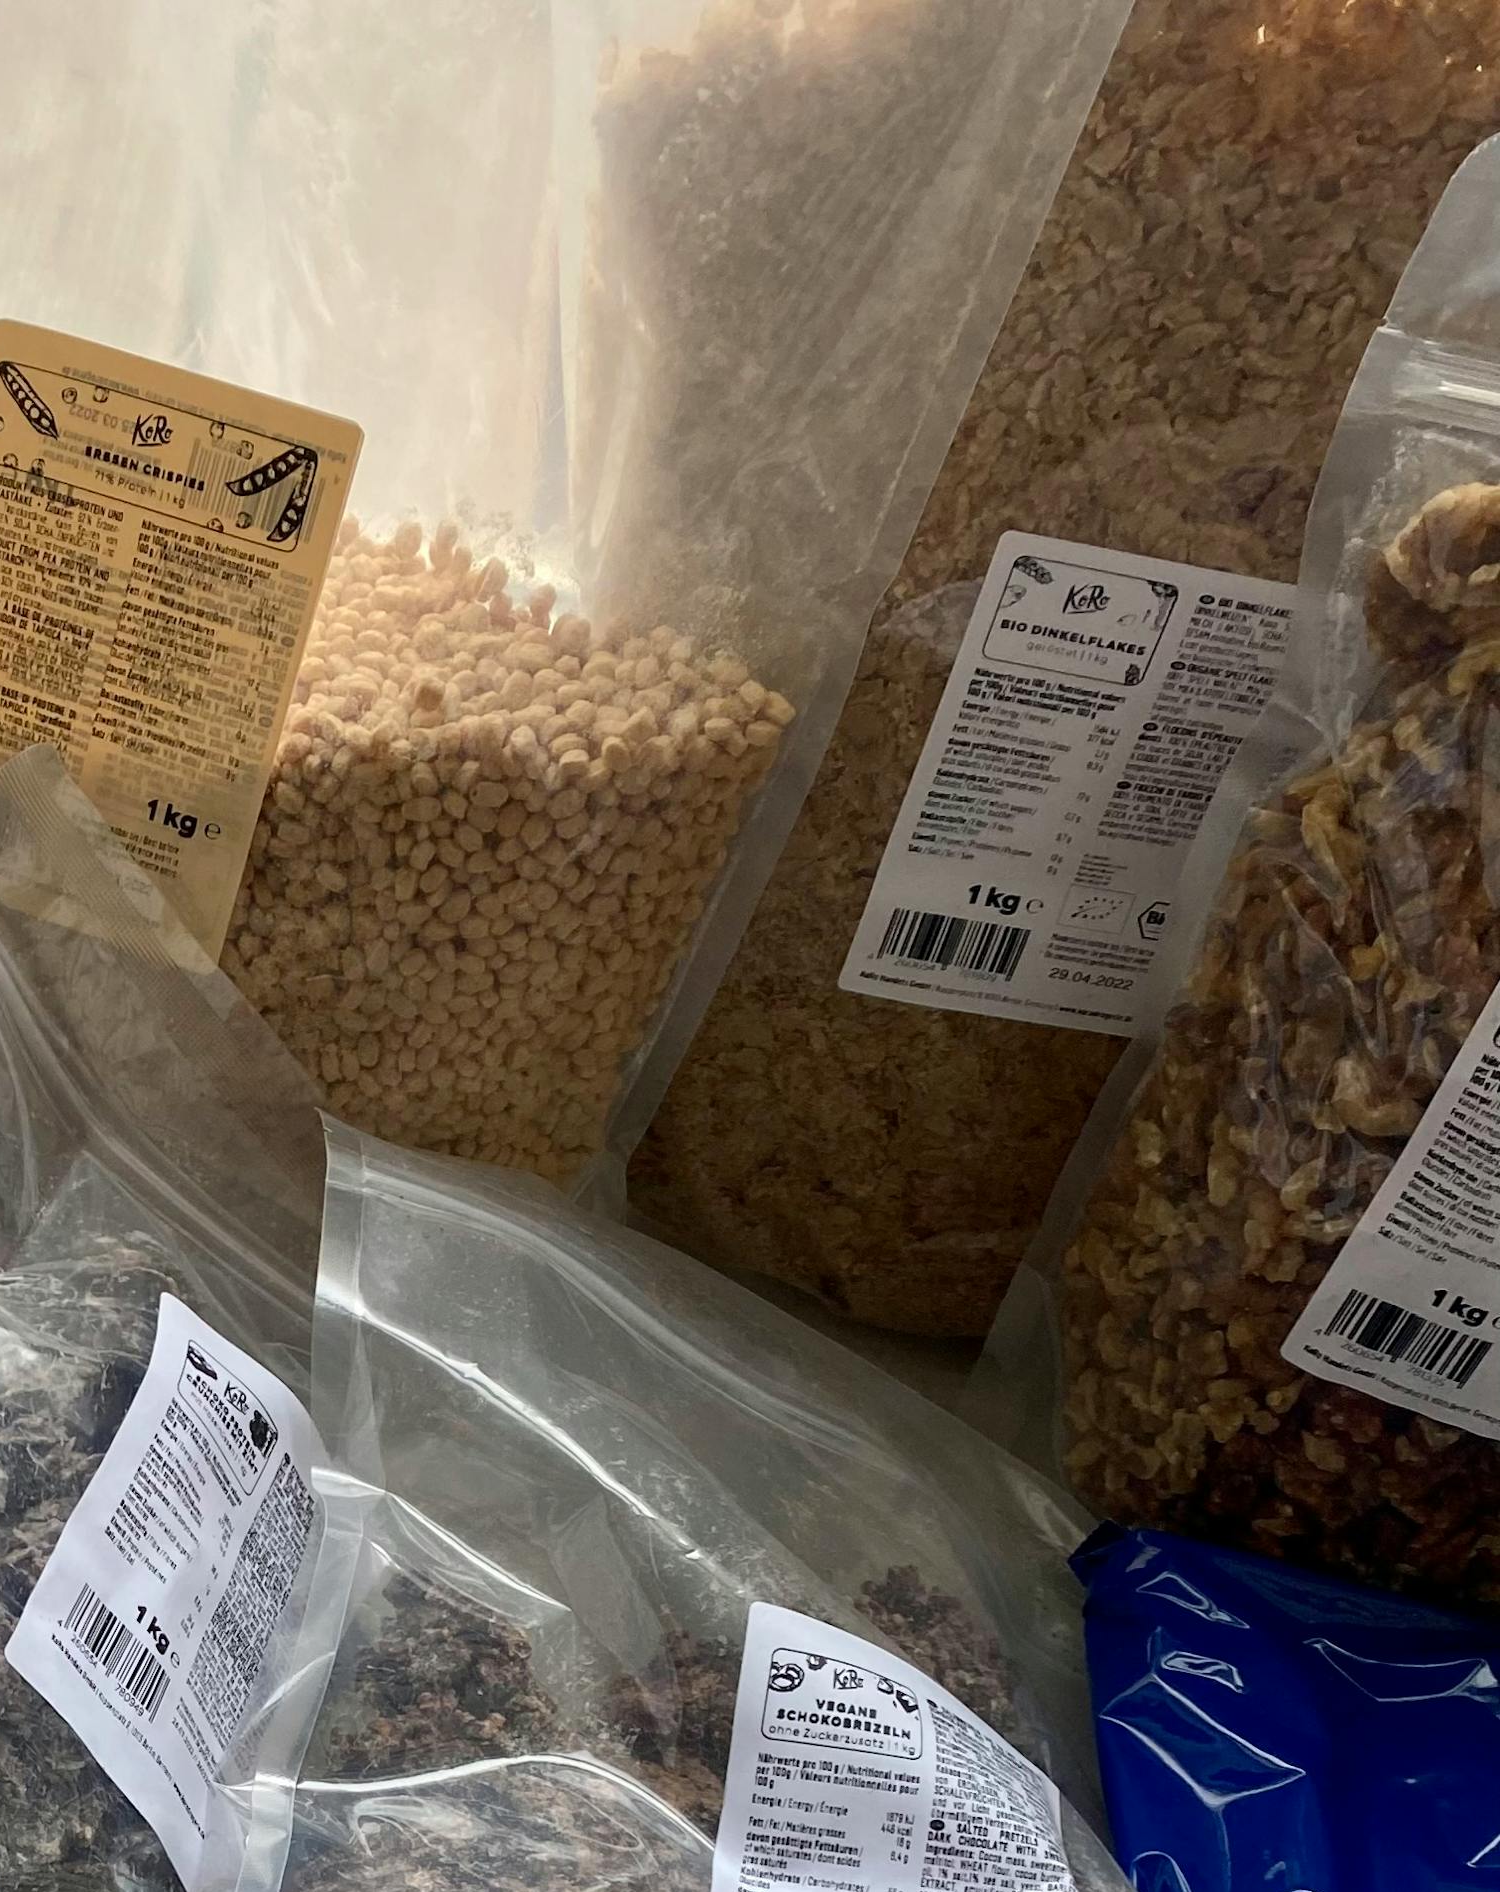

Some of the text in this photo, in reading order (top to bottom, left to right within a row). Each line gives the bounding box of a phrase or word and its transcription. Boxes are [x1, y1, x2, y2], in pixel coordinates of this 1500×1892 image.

[132, 414, 173, 447] KoRo
[85, 446, 205, 491] ERBSEN CRISPIES
[1063, 585, 1112, 614] KoRo
[1000, 619, 1147, 656] BIO DINKELFLAKES
[147, 799, 199, 840] 1 kg
[968, 884, 1021, 915] 1 kg
[1048, 967, 1134, 990] 29.04.2022
[1431, 1289, 1489, 1326] 1 kg
[136, 1605, 170, 1656] 1 kg
[115, 1681, 145, 1717] 780949
[816, 1699, 877, 1719] VEGANE
[769, 1725, 800, 1737] ohne
[803, 1728, 884, 1749] Zuckerzusatz
[776, 1709, 911, 1740] SCHOKOBREZELN
[758, 1752, 800, 1768] Nährwerte
[927, 1831, 1009, 1854] DARK CHOCOLATE
[956, 1823, 1039, 1847] SALTED PRETZELS
